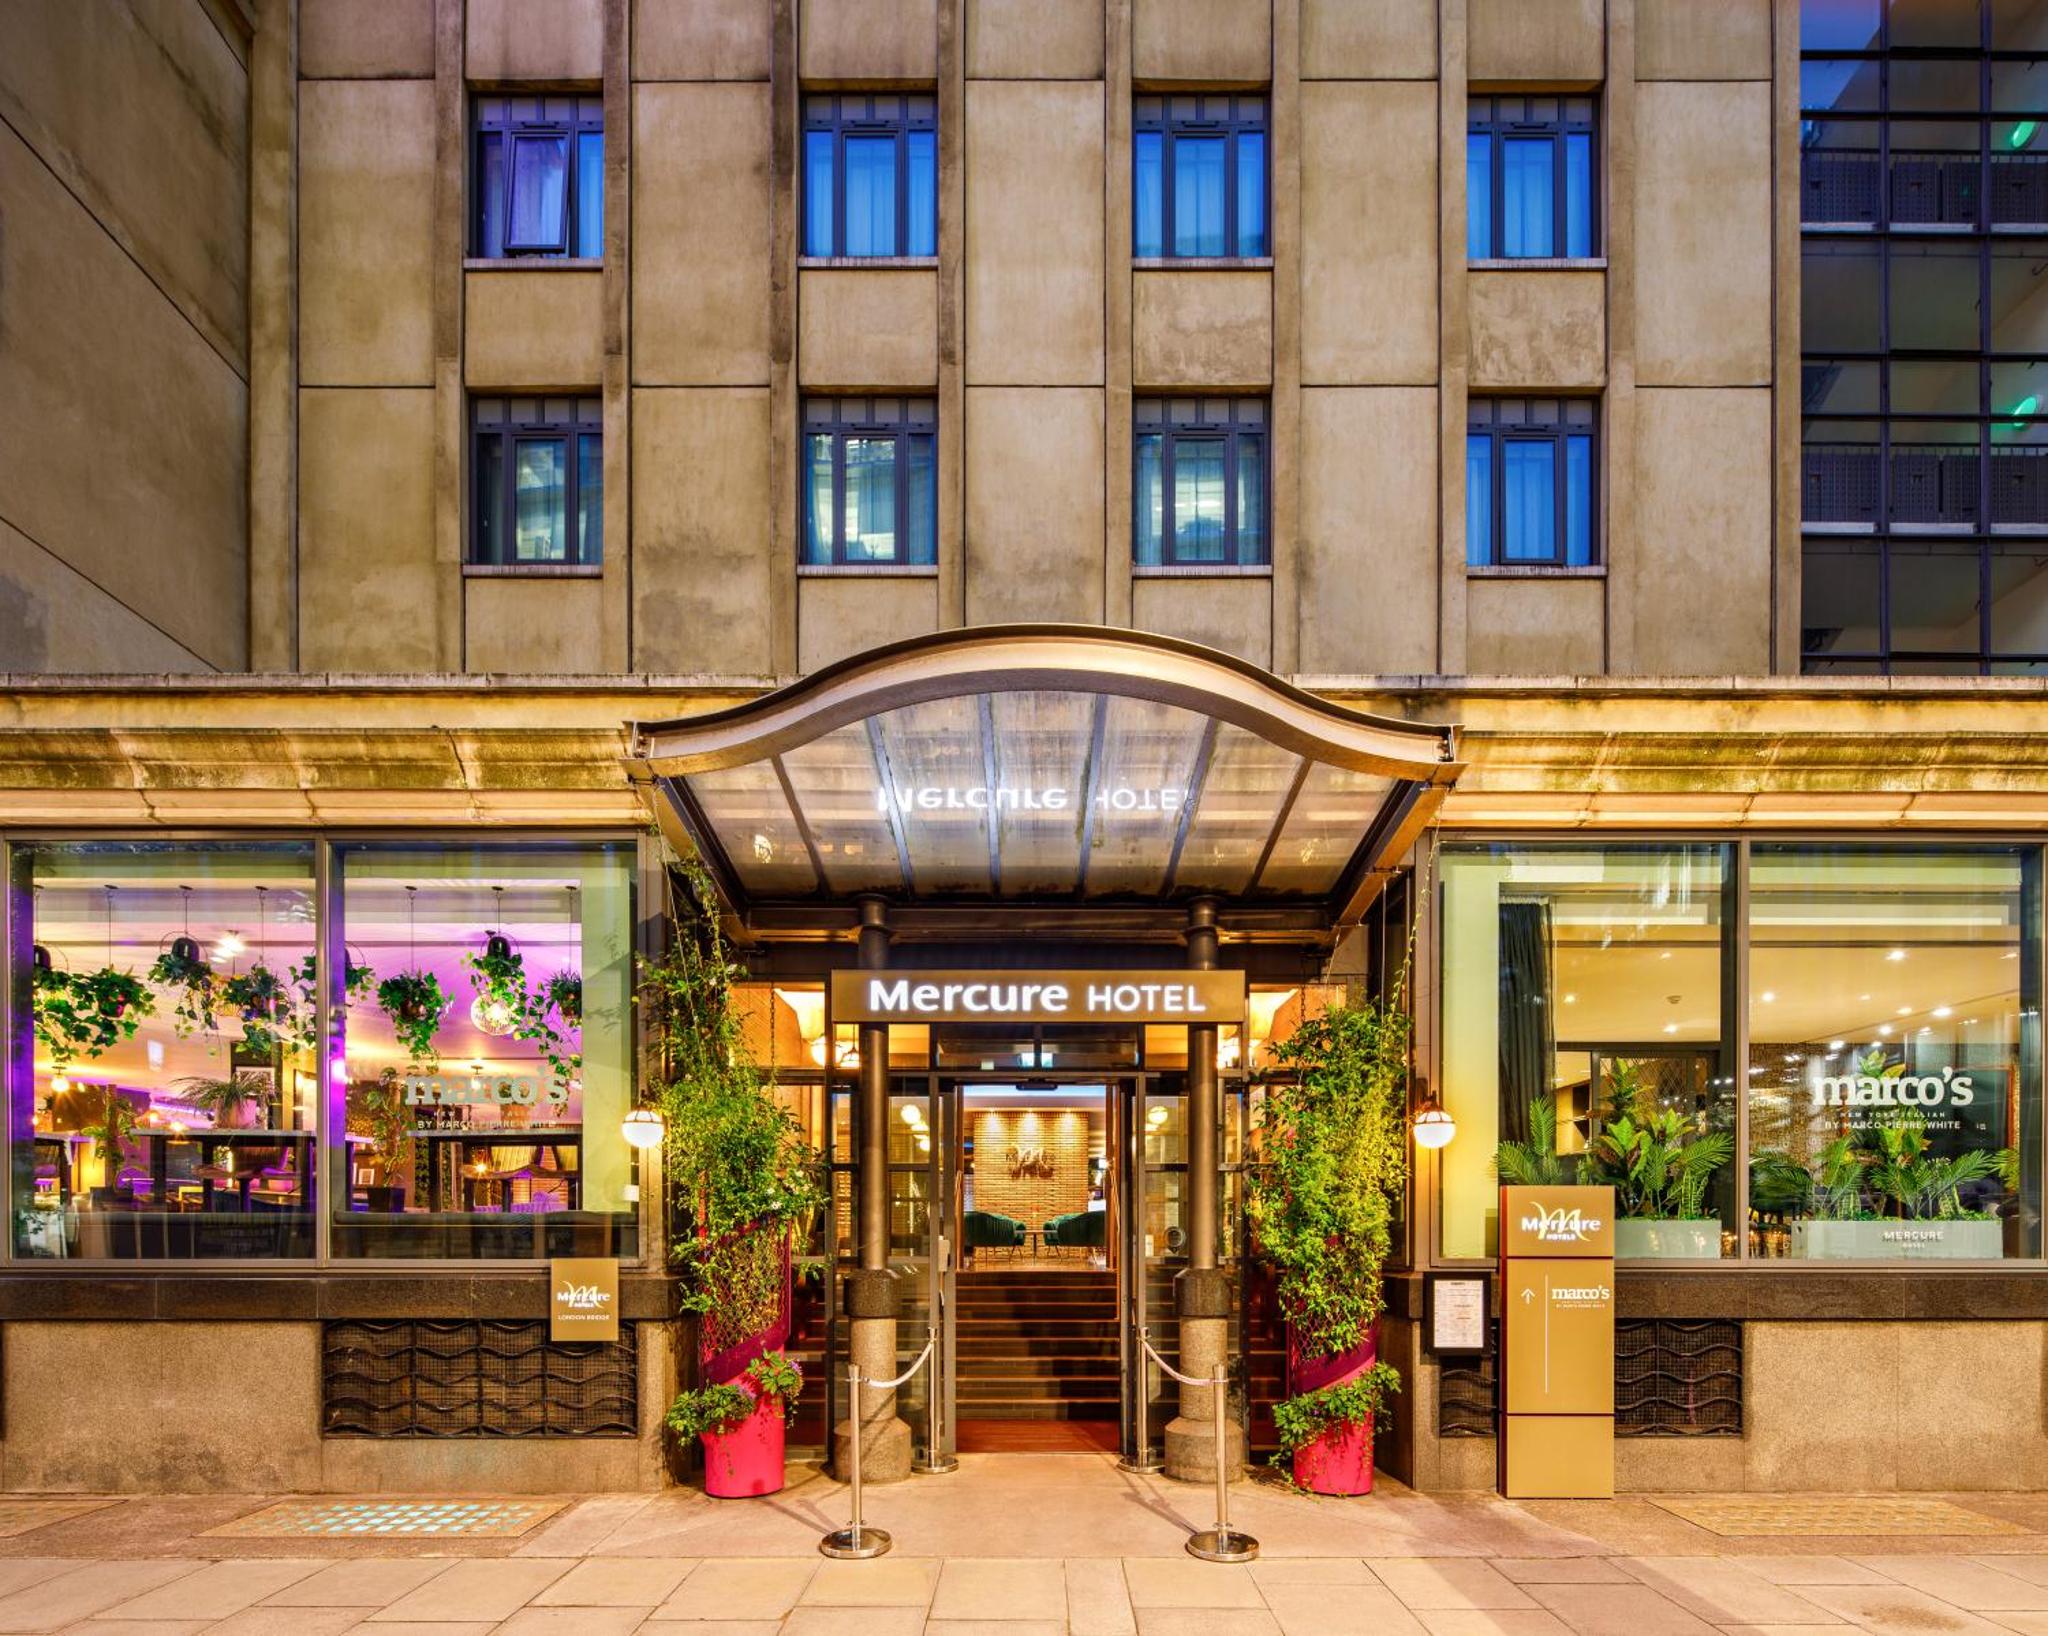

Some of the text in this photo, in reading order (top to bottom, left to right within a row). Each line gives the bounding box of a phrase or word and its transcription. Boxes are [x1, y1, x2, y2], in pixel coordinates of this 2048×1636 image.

[869, 980, 1207, 1012] Mercure HOTEL
[405, 1065, 569, 1106] marco's
[1812, 1066, 1974, 1107] marco's
[417, 1120, 433, 1129] BY
[1824, 1120, 1961, 1130] BY MARCO PIERRE WHITE
[1884, 1231, 1945, 1240] MERCURE
[1551, 1285, 1611, 1300] marco's
